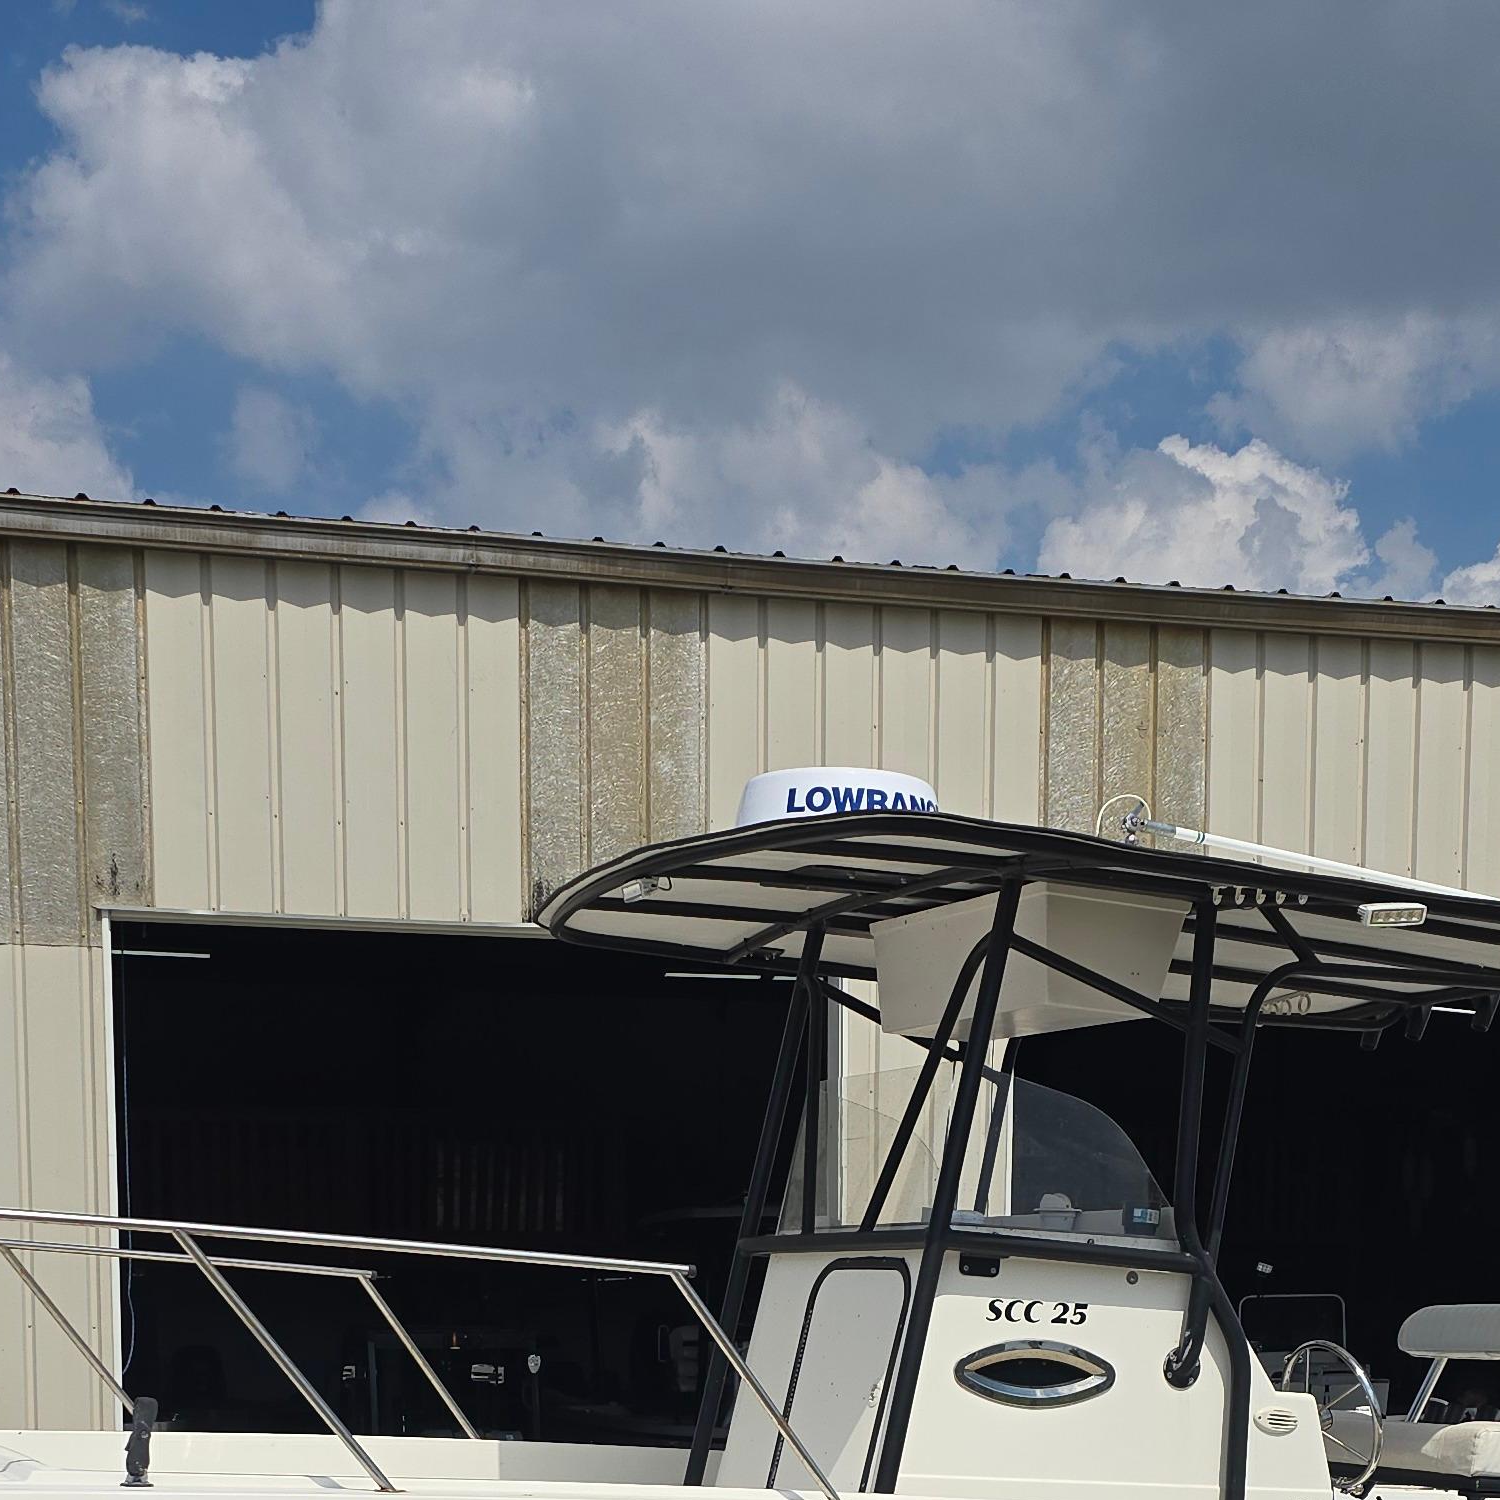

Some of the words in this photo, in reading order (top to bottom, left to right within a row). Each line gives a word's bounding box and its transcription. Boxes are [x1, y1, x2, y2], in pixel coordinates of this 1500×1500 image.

[786, 786, 939, 813] LOWRAN
[985, 1298, 1044, 1324] SCC
[1050, 1302, 1089, 1326] 25
